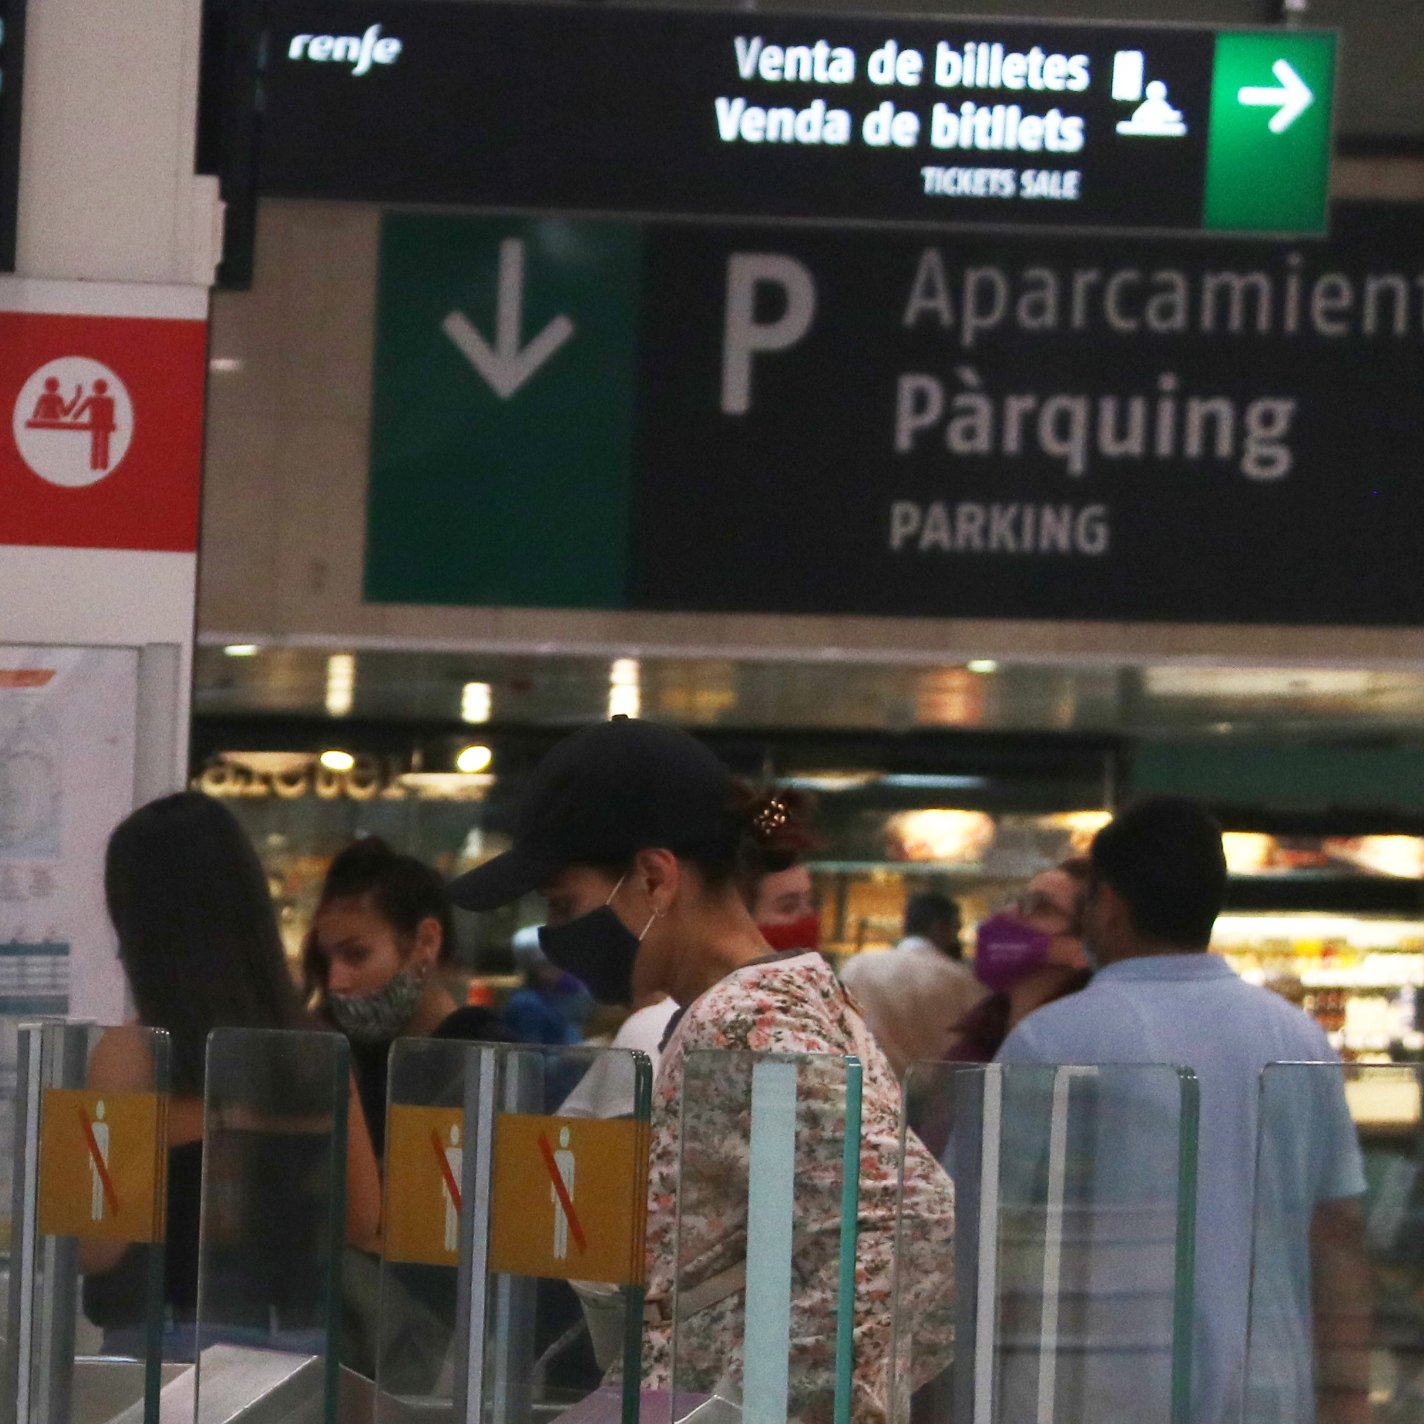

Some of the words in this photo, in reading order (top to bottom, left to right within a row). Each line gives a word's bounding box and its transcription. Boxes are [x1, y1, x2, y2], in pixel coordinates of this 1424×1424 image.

[288, 25, 402, 76] renfe
[735, 37, 856, 86] Venta
[867, 43, 922, 87] de
[935, 43, 1090, 92] billetes
[715, 97, 849, 147] Venda
[863, 103, 918, 149] de
[931, 103, 1084, 154] bitllets
[921, 165, 1013, 197] TICKETS
[1019, 169, 1080, 199] SALE
[721, 253, 816, 416] P
[895, 366, 1296, 481] Pàrquing
[890, 501, 1109, 555] PARKING
